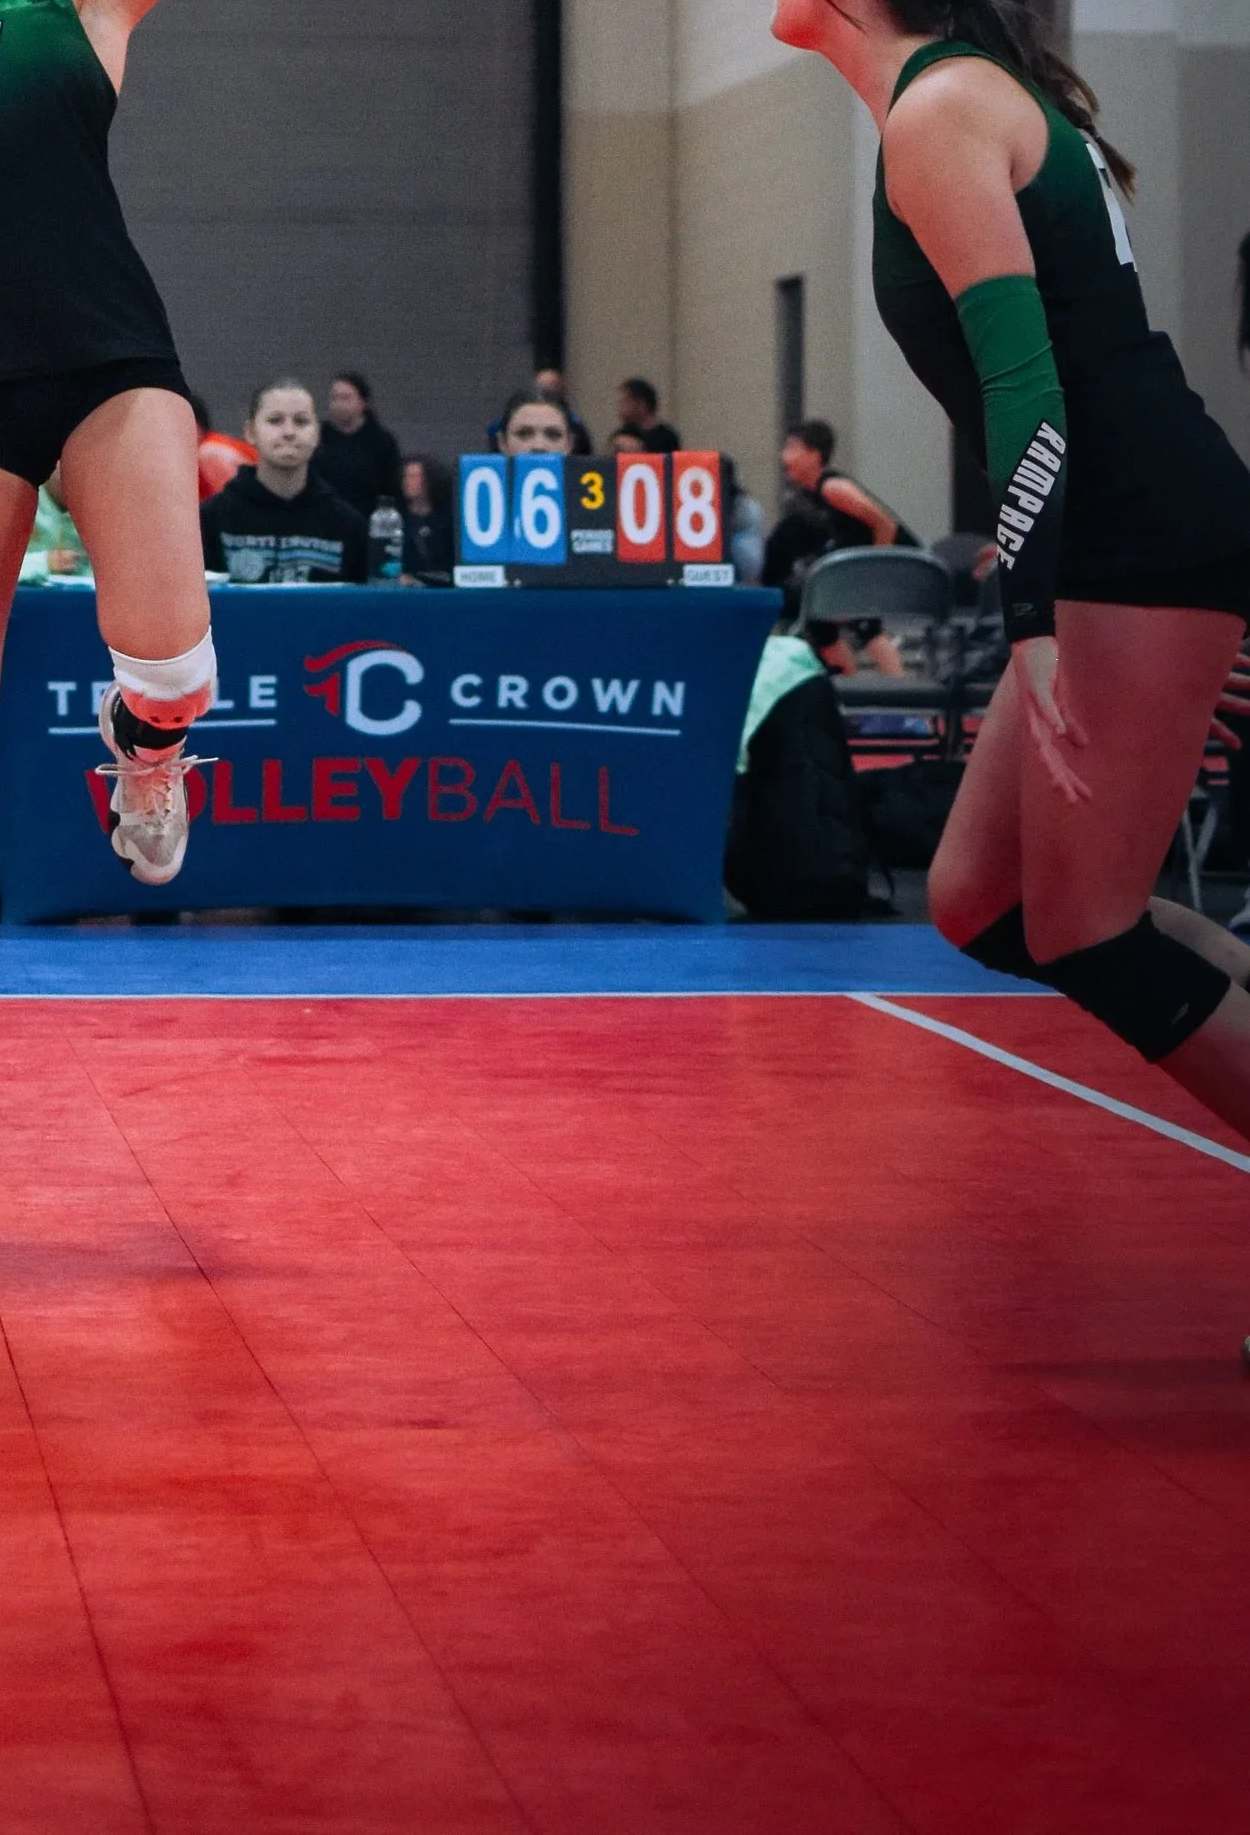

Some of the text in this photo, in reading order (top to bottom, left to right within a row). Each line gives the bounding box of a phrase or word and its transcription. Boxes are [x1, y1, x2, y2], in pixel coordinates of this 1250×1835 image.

[579, 471, 606, 510] 3
[996, 421, 1066, 571] RAMPAGE
[47, 674, 686, 716] TLE CROWN
[85, 756, 640, 836] VLLEYBALL
